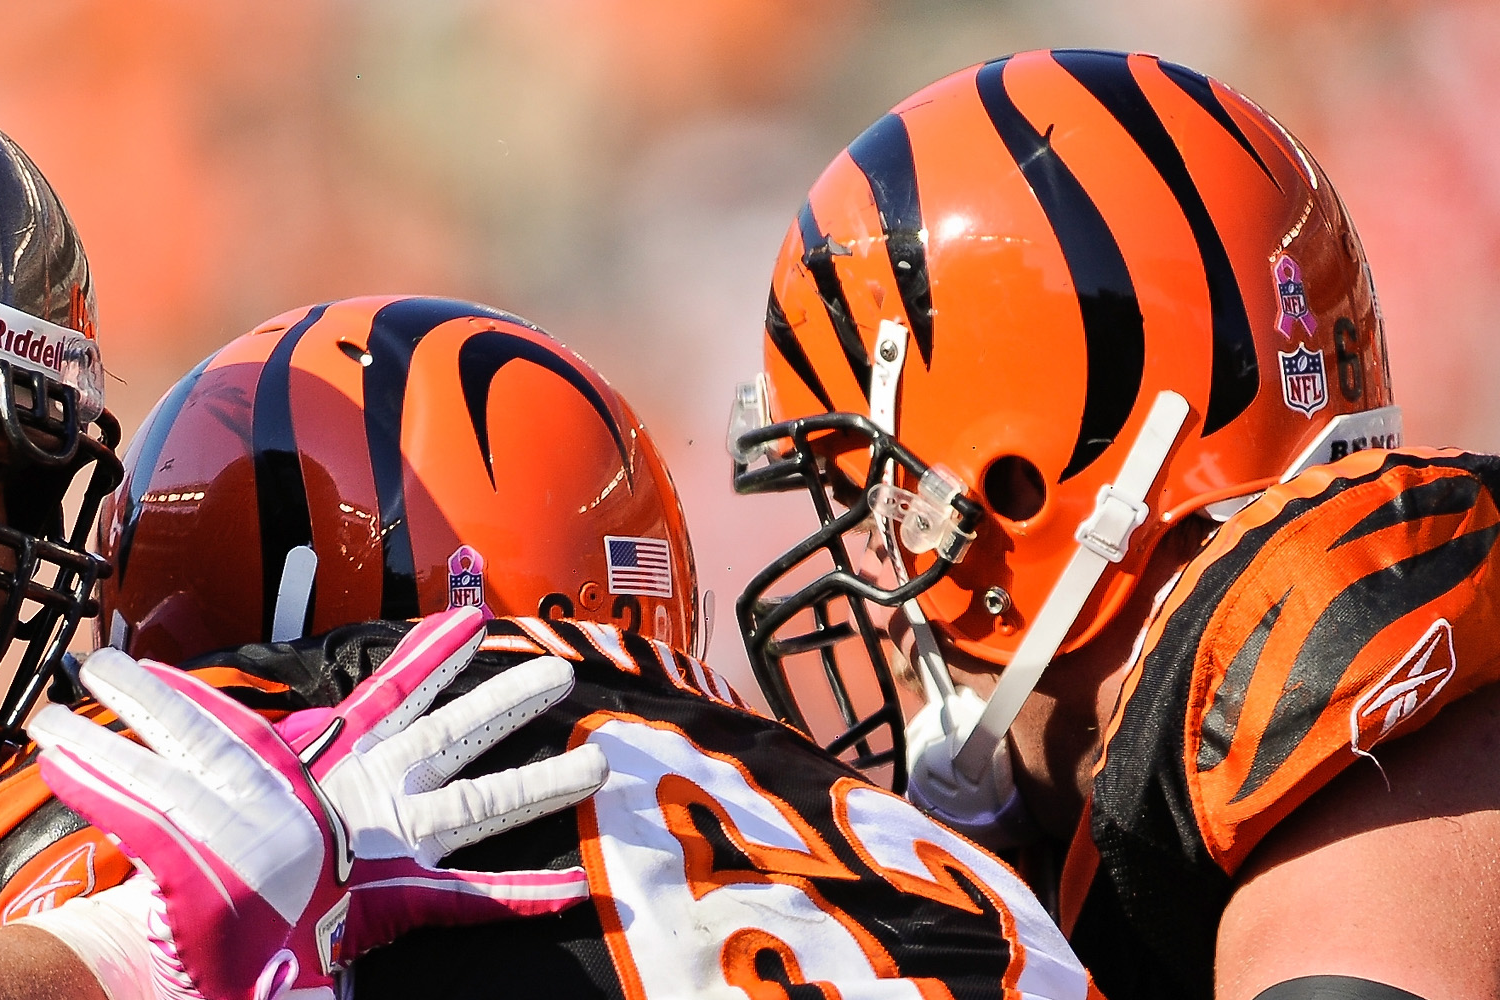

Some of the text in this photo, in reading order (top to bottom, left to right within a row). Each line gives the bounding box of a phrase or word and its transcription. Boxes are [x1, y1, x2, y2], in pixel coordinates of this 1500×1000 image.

[1283, 294, 1307, 314] NFL
[1288, 374, 1322, 405] NFL
[452, 588, 480, 607] NFL
